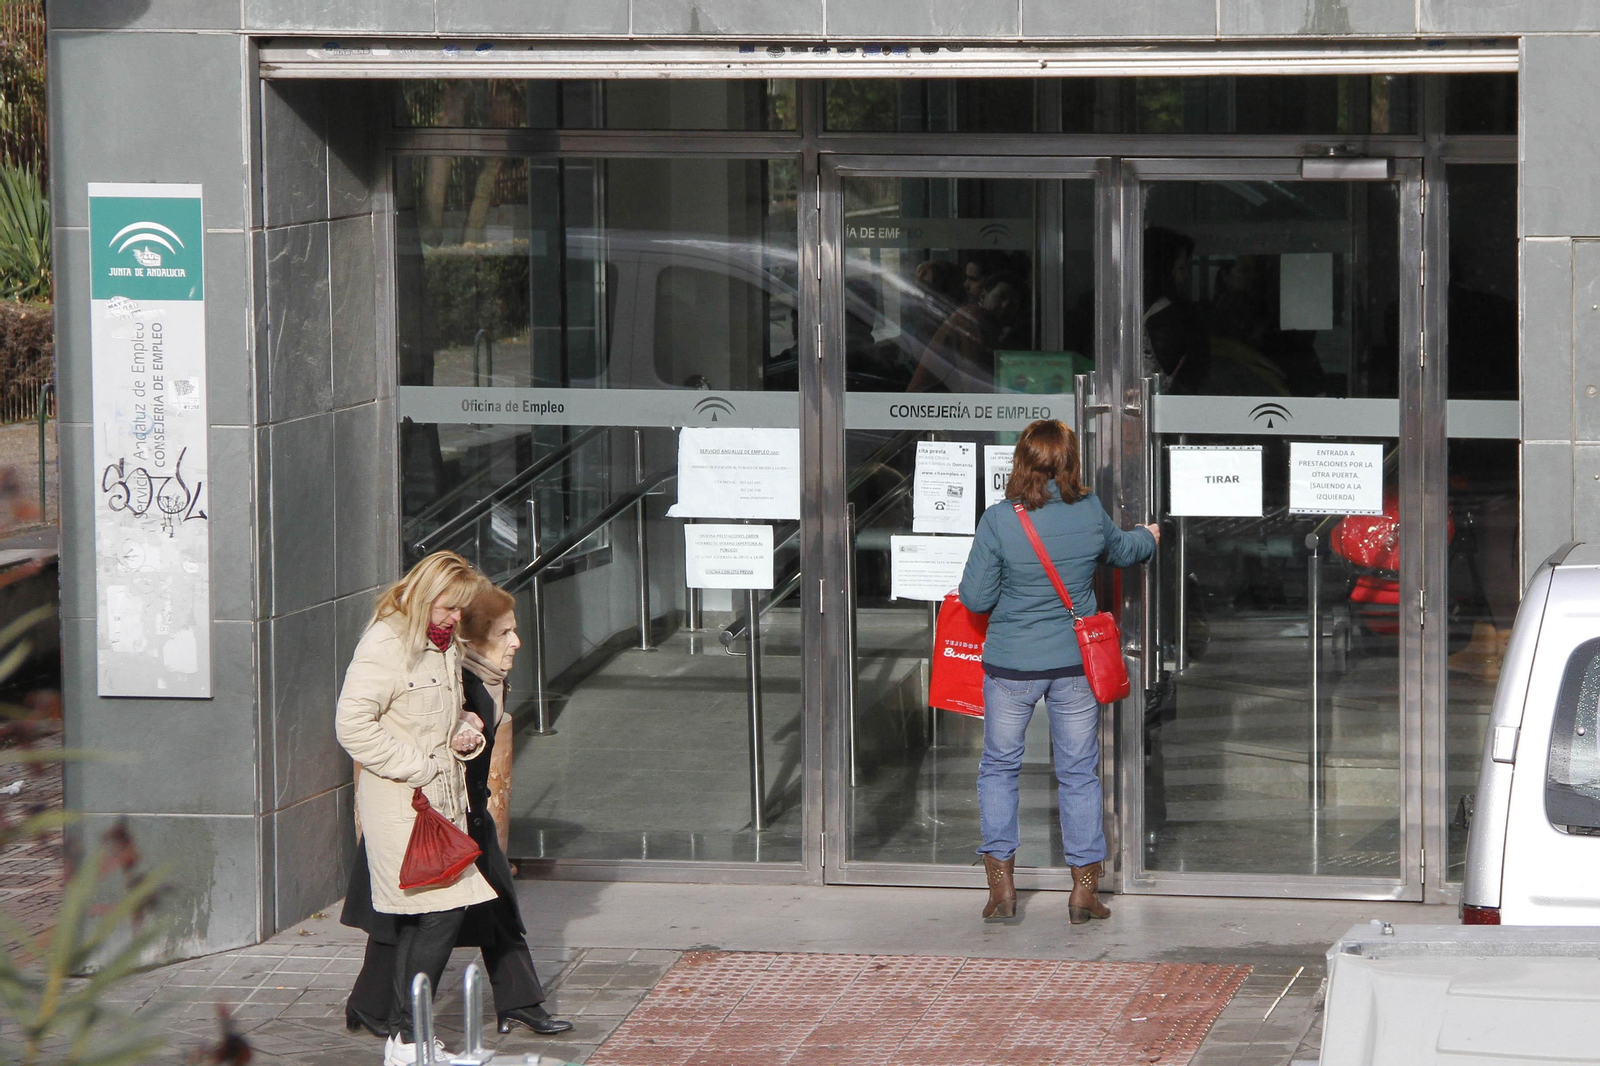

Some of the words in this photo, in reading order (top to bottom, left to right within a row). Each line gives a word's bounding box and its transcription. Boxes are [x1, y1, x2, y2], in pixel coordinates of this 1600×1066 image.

[860, 228, 875, 238] DE
[108, 268, 132, 276] JUNTA
[134, 268, 144, 276] DE
[130, 322, 148, 373] Empleo
[152, 322, 164, 370] EMPLEO
[132, 380, 146, 397] de
[153, 375, 164, 390] DE
[462, 399, 501, 412] Oficina
[505, 400, 518, 412] de
[522, 400, 564, 415] Empleo
[890, 402, 970, 418] CONSEJERÍA
[974, 406, 992, 419] DE
[996, 406, 1050, 420] EMPLEO
[132, 404, 147, 460] Andaluz
[151, 395, 166, 468] CONSEJERÍA
[1298, 460, 1348, 468] PRESTACIONES
[1204, 475, 1240, 484] TIRAR
[1310, 482, 1345, 490] (SALIENDO
[134, 468, 148, 519] Servicio
[1316, 493, 1355, 501] IZQUIERDA)
[945, 640, 978, 650] TEJIDOS
